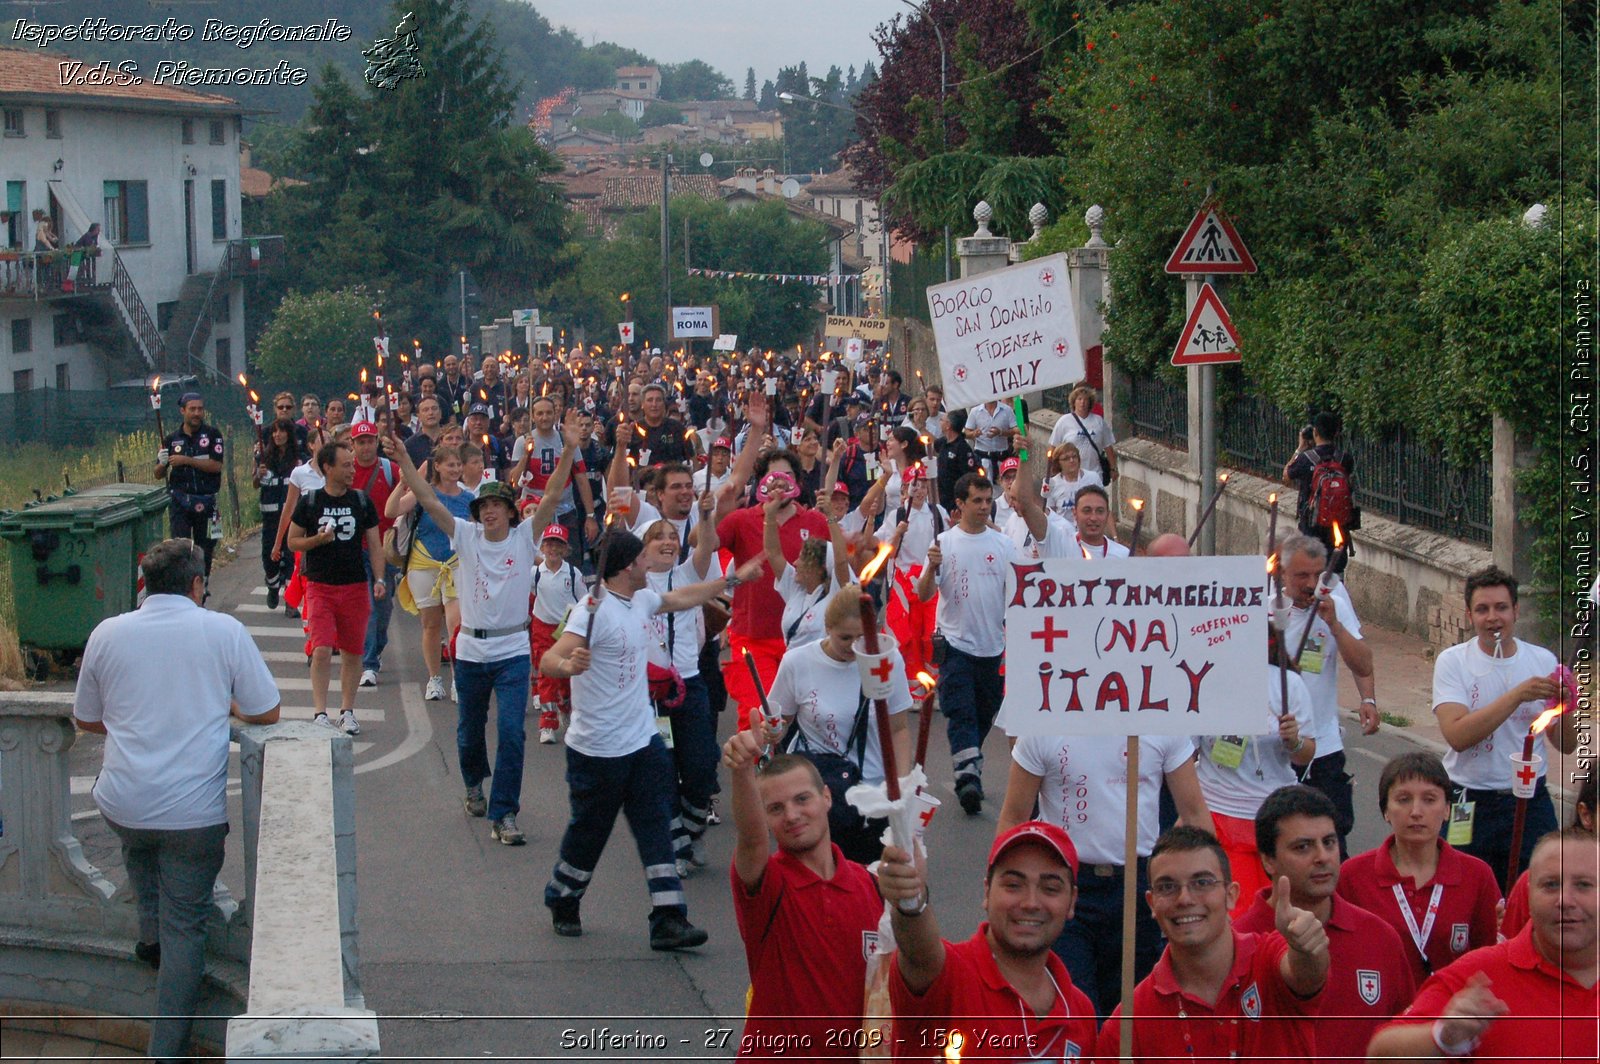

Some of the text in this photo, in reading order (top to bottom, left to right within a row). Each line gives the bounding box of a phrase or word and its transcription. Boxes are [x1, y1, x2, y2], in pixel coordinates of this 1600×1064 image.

[931, 287, 993, 318] BORGO
[677, 320, 708, 329] ROMA
[828, 317, 885, 329] ROMA NORD
[956, 313, 981, 337] SAN
[990, 359, 1042, 394] ITALY
[323, 507, 352, 516] RAMS
[961, 568, 969, 600] 2009
[1095, 613, 1179, 660] (NA)
[1190, 614, 1250, 636] SOLFERINO
[1207, 630, 1232, 647] 2009
[826, 713, 840, 750] 2009
[1076, 774, 1088, 824] 2009
